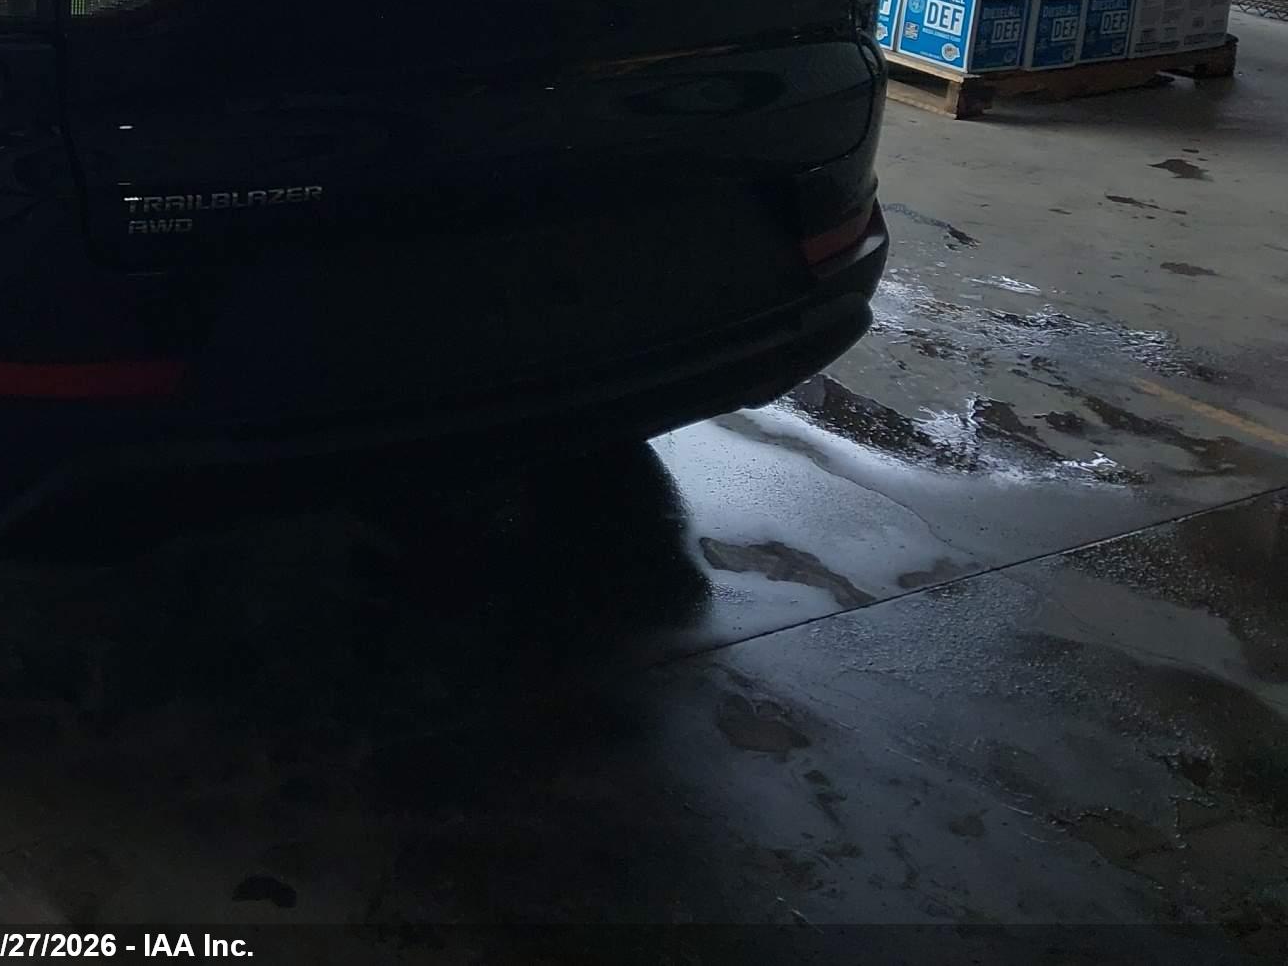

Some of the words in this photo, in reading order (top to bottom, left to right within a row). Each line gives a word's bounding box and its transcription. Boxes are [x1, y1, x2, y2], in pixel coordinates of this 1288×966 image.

[926, 0, 963, 32] DEF
[1102, 12, 1127, 32] DEF
[994, 21, 1020, 40] DEF
[1053, 19, 1077, 39] DEF
[123, 186, 323, 214] TRAILBLAZER
[128, 218, 193, 235] AWD
